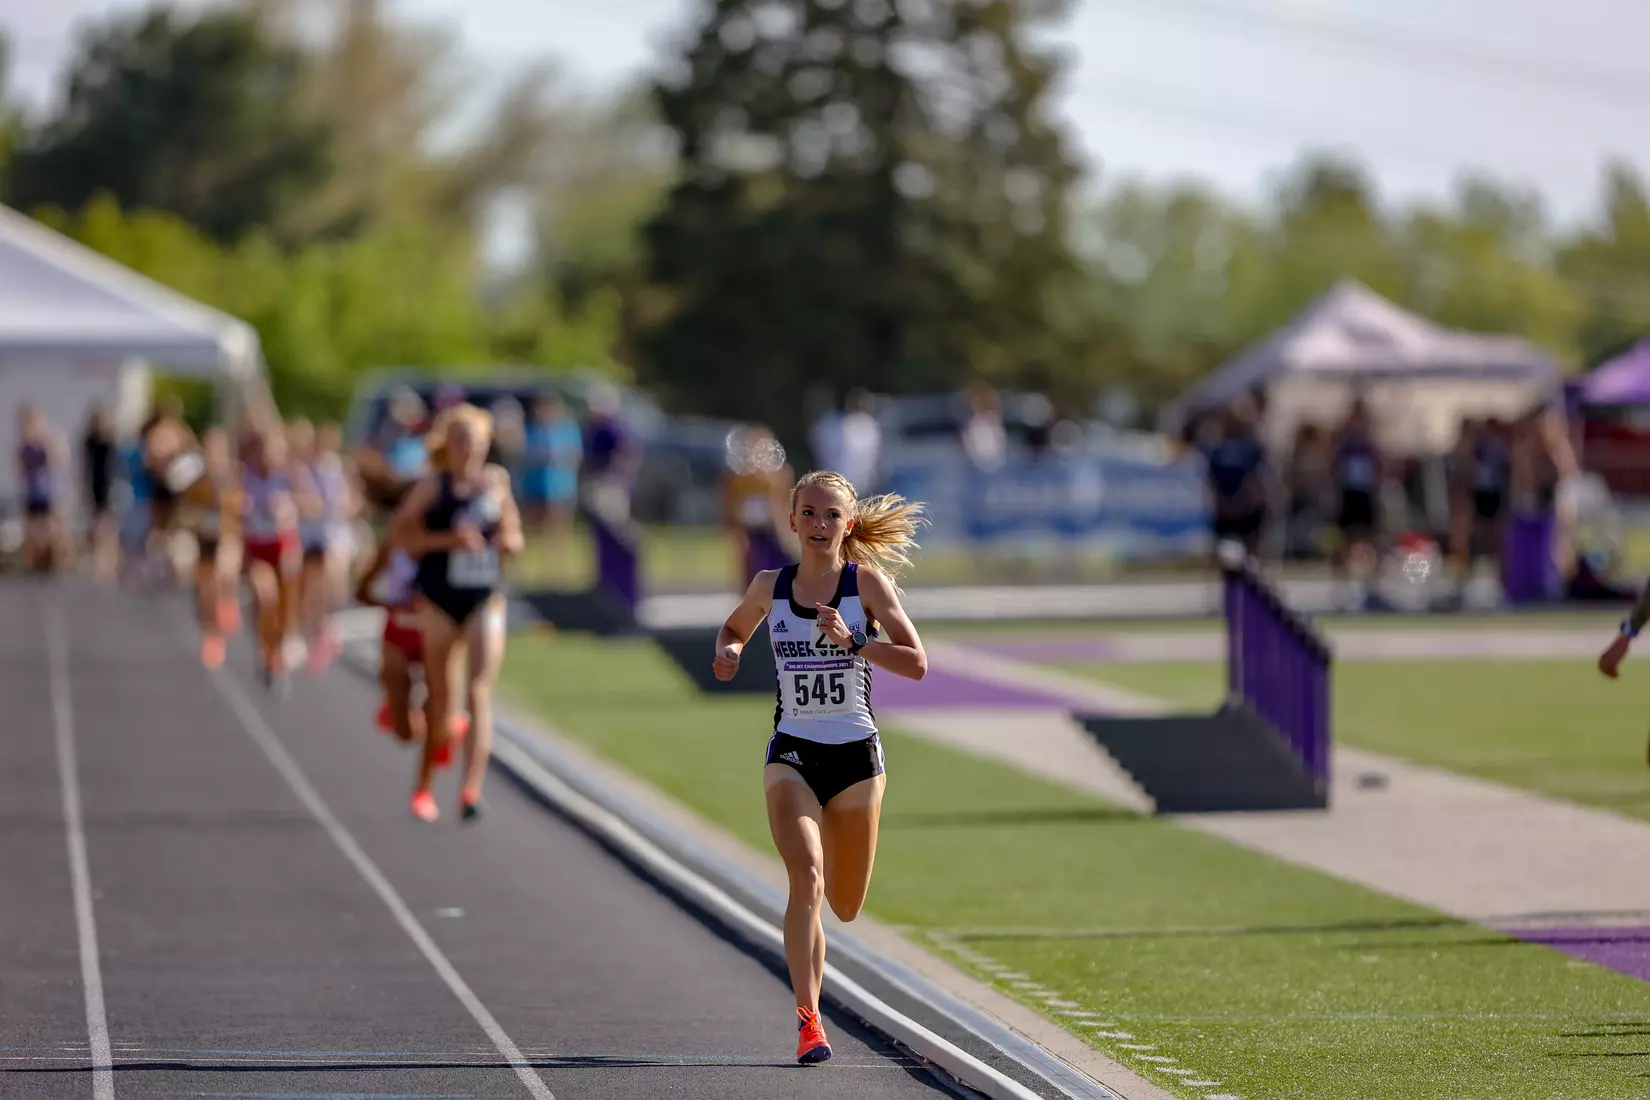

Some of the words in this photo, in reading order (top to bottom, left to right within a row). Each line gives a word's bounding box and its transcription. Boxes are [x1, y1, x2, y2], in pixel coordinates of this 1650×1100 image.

[773, 640, 816, 658] WEBER
[794, 672, 845, 706] 545
[779, 754, 803, 766] adidas
